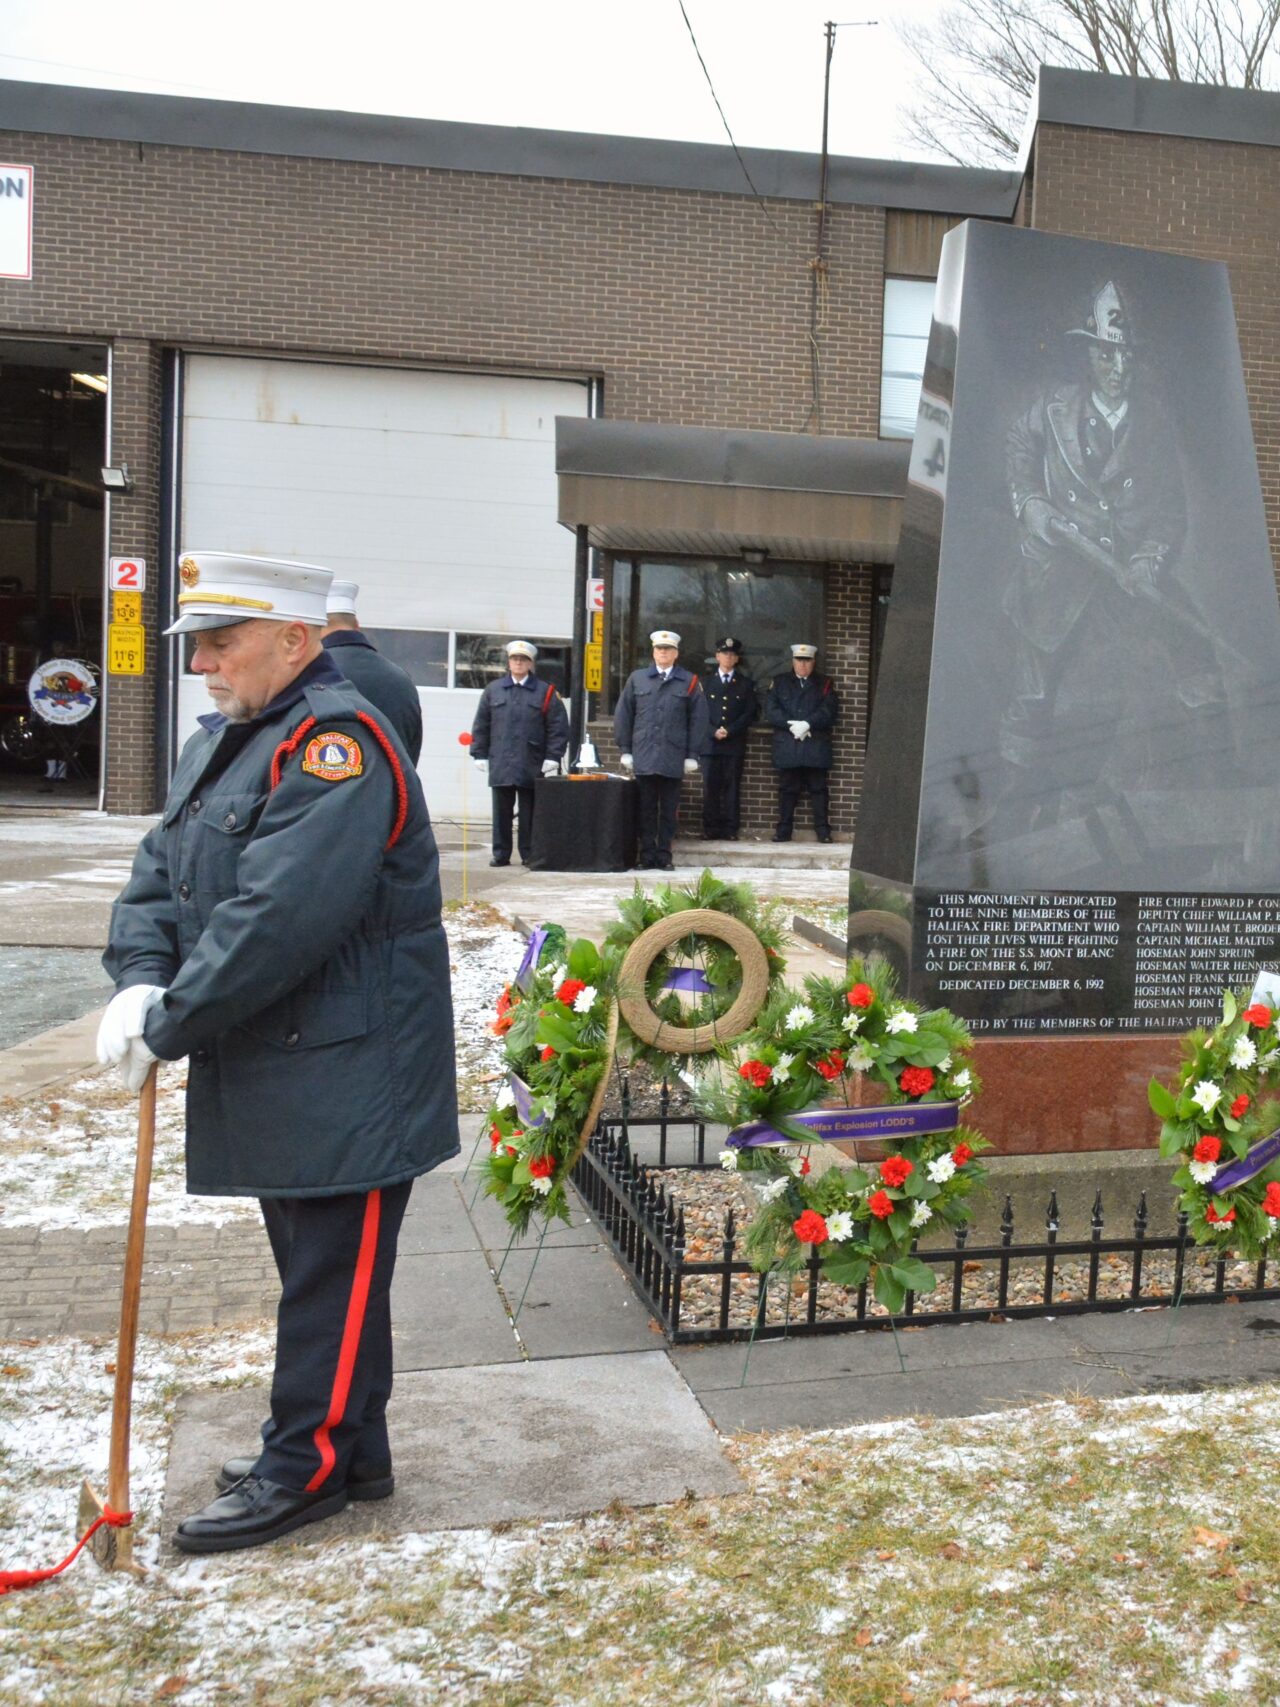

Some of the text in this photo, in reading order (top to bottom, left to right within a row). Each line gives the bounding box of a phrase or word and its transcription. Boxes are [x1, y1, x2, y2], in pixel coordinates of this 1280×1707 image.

[117, 562, 138, 586] 2
[321, 734, 349, 744] HALIFAX
[938, 894, 1117, 907] THIS MONUMENT IS DEDICATED
[1138, 897, 1163, 907] FIRE
[1165, 897, 1198, 907] CHIEF
[1201, 898, 1245, 908] EDWARD
[927, 908, 1116, 920] TO THE NINE MEMBERS OF THE
[1138, 910, 1180, 920] DEPUTY
[1182, 910, 1215, 920] CHIEF
[1217, 911, 1261, 921] WILLIAM
[927, 921, 1120, 932] HALIFAX FIRE DEPARTMENT WHO
[1137, 923, 1182, 933] CAPTAIN
[1185, 923, 1230, 933] WILLIAM
[927, 934, 1119, 945] LOST THEIR LIVES WHILE FIGHTING
[1136, 936, 1274, 946] CAPTAIN MICHAEL MALTUS
[926, 948, 1115, 958] A FIRE ON THE S.S. MONT BLANC
[1136, 948, 1255, 958] HOSEMAN JOHN SPRUIN
[925, 961, 943, 971] ON
[948, 961, 1016, 971] DECEMBER
[1020, 961, 1029, 972] 6,
[1135, 961, 1186, 971] HOSEMAN
[1190, 961, 1230, 971] WALTER
[1135, 973, 1258, 984] HOSEMAN FRANK KILLE
[939, 979, 1104, 991] DEDICATED DECEMBER 6, 1992
[1134, 986, 1185, 996] HOSEMAN
[1188, 986, 1223, 996] FRANK
[1134, 999, 1185, 1009] HOSEMAN
[1188, 999, 1215, 1009] JOHN
[965, 1016, 1221, 1029] TED BY THE MEMBERS OF THE HALIFAX FIRE
[804, 1123, 832, 1132] alifax
[835, 1120, 878, 1131] Explosion
